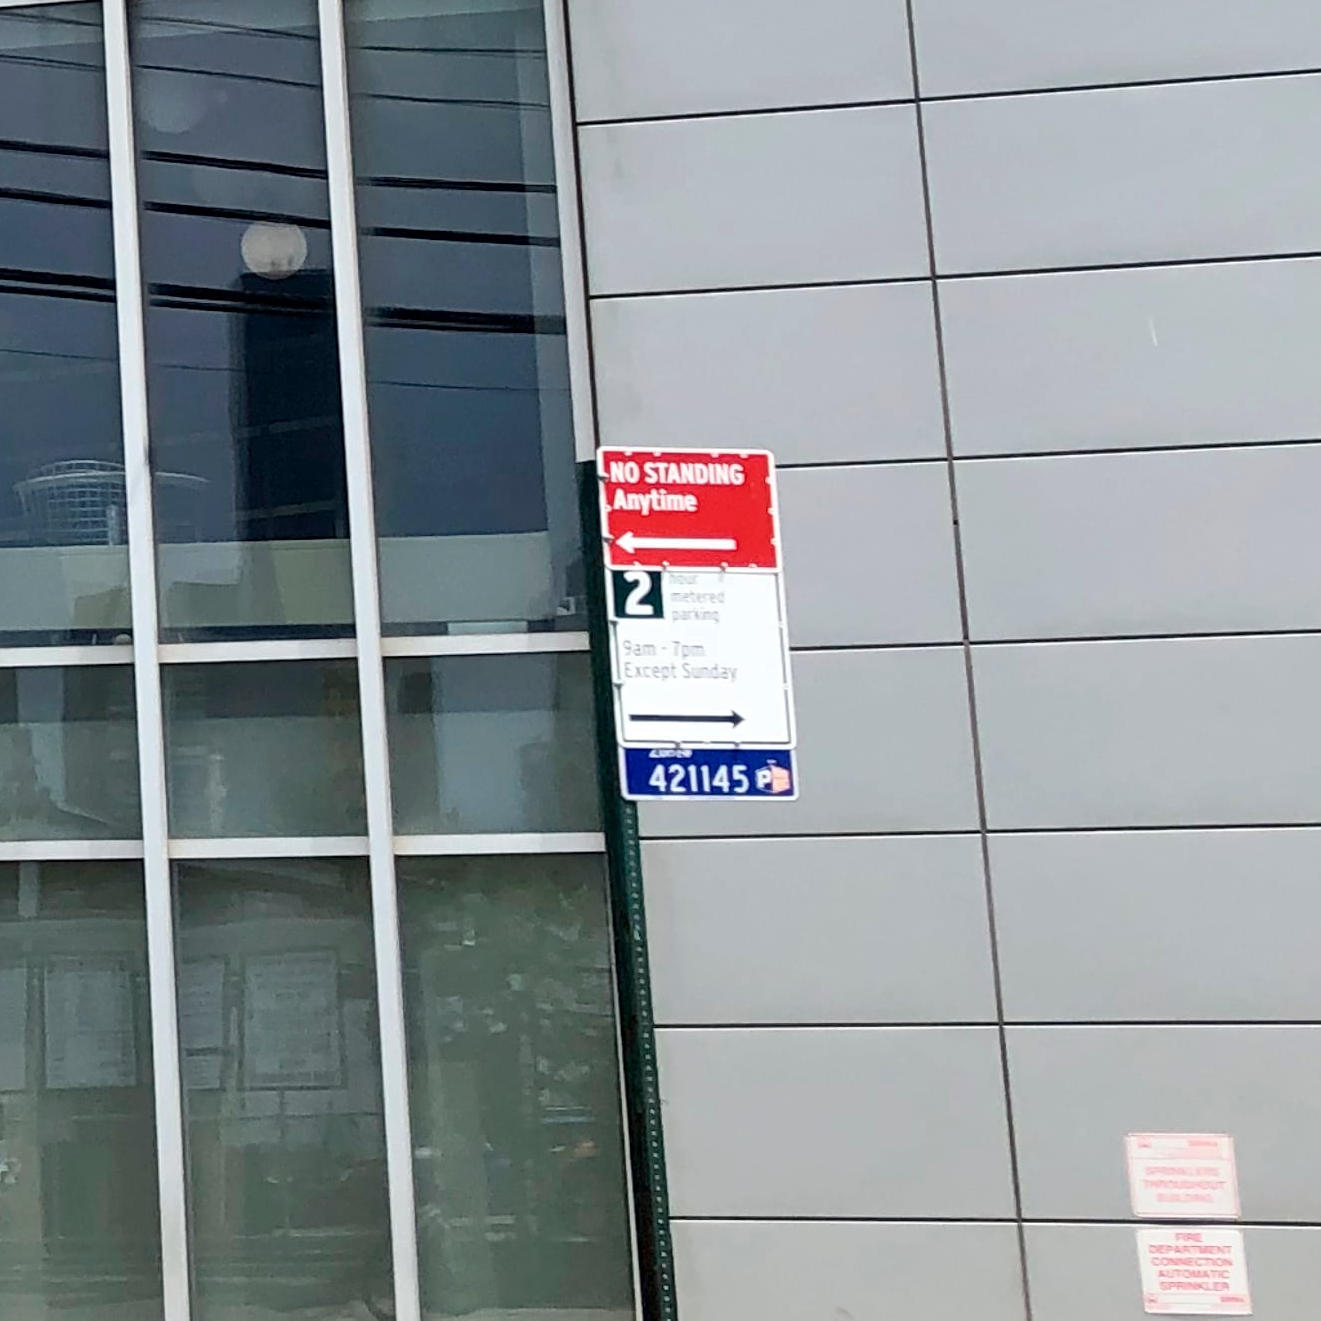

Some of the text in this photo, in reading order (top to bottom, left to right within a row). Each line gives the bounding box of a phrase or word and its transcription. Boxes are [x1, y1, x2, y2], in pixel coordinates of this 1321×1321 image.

[609, 461, 746, 487] NO STANDING
[612, 488, 699, 516] Anytime
[623, 570, 655, 616] 2
[669, 590, 726, 604] metered
[671, 608, 720, 624] parking
[622, 640, 657, 657] 9am
[671, 641, 705, 660] 7pm
[623, 662, 738, 683] Except Sunday
[648, 764, 750, 795] 421145
[1174, 1232, 1204, 1243] FIRE
[1148, 1244, 1233, 1254] DEPARTMENT
[1151, 1257, 1234, 1267] CONNECTION
[1158, 1269, 1231, 1279] AUTOMATIC
[1159, 1281, 1230, 1292] SPRINKLER
